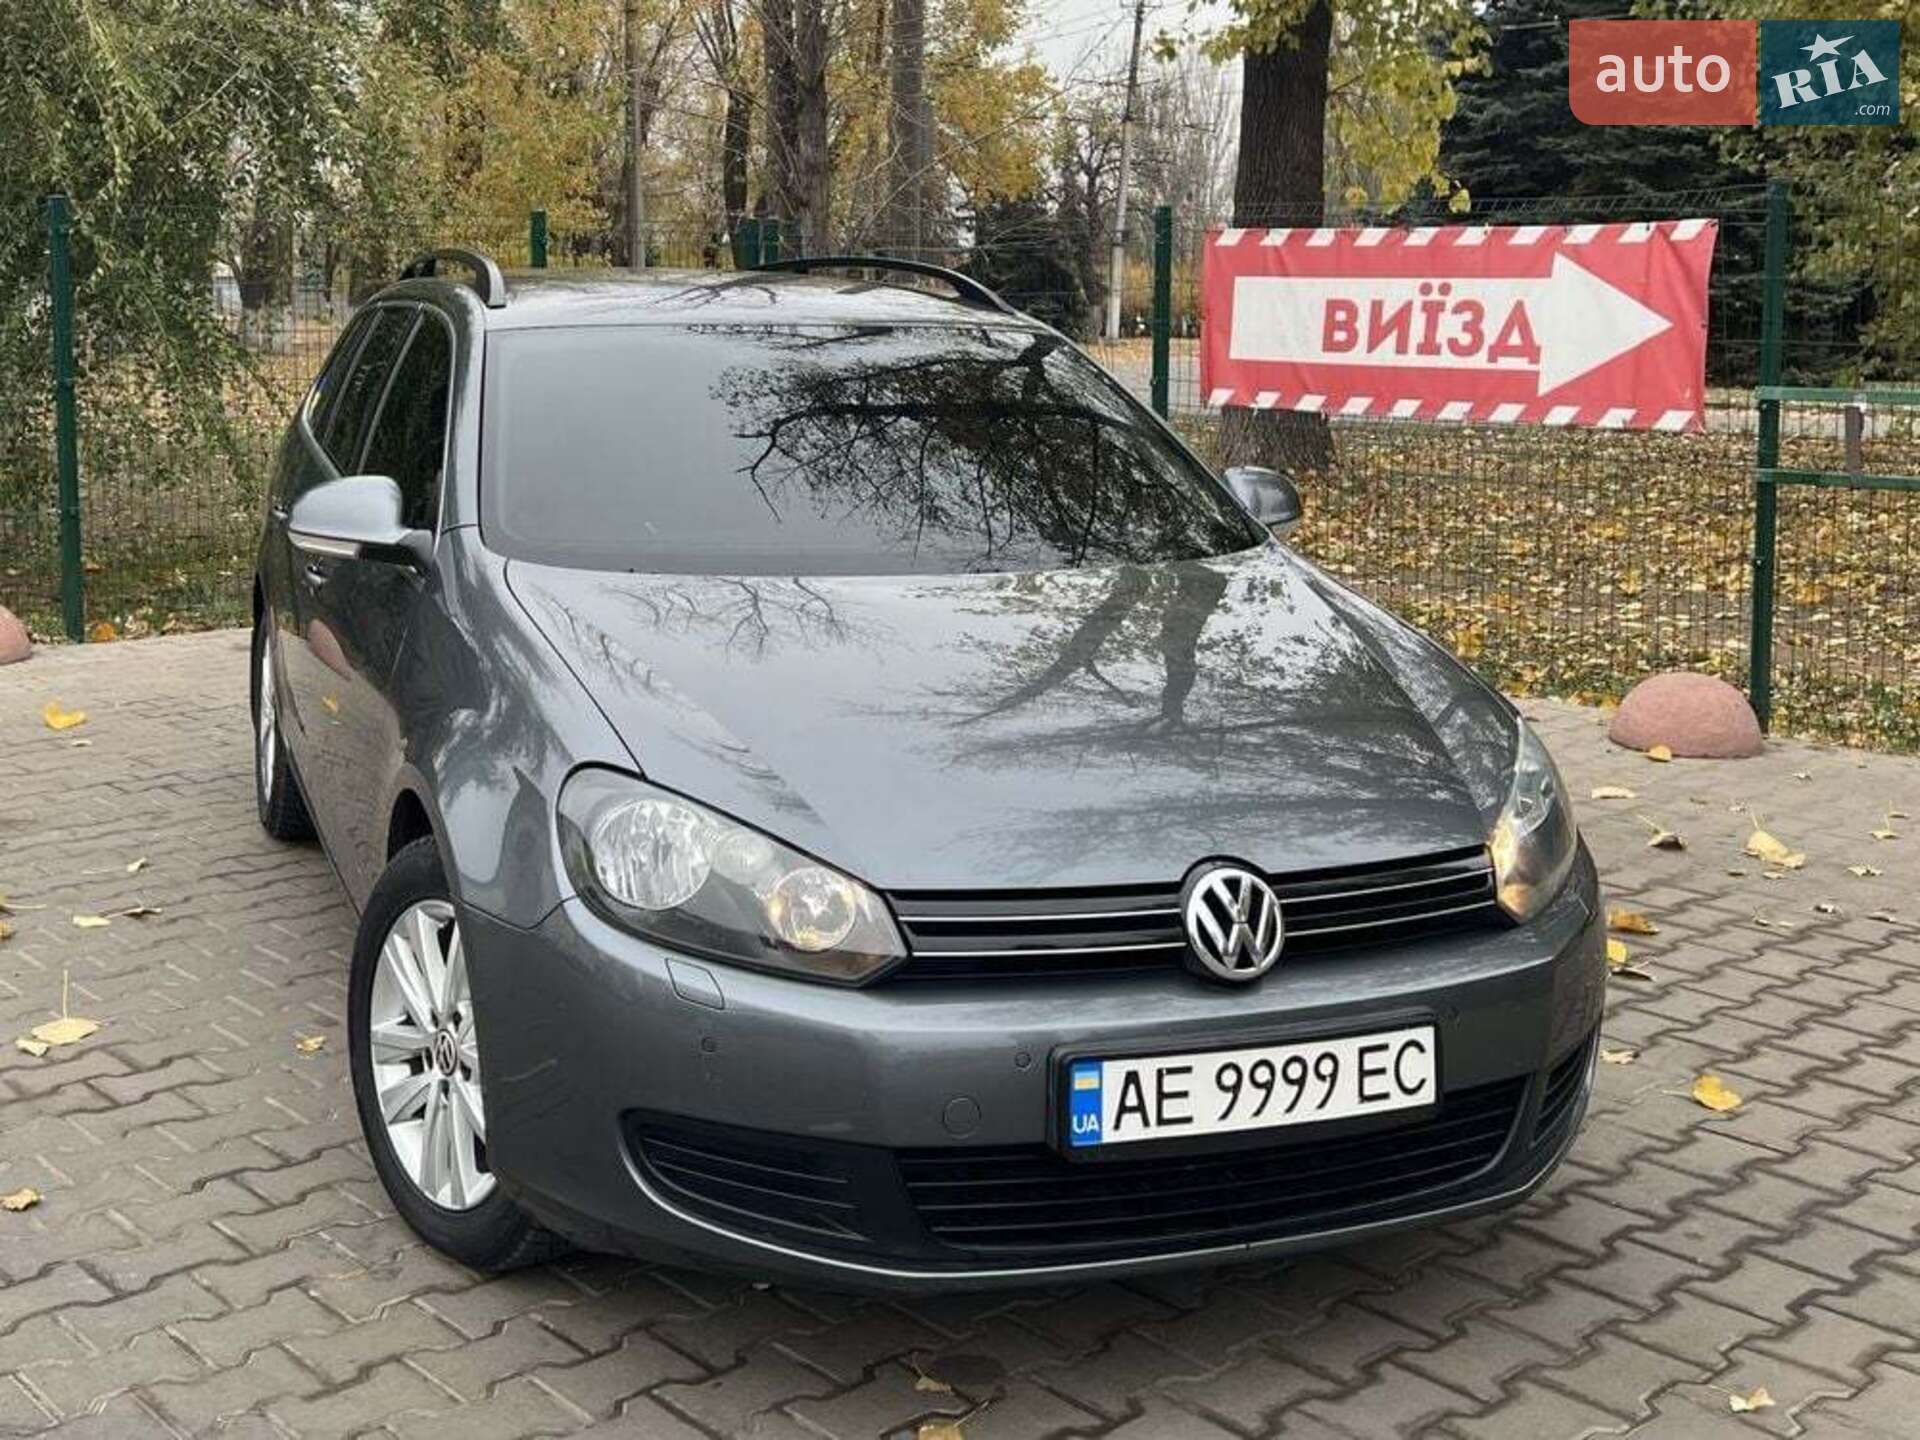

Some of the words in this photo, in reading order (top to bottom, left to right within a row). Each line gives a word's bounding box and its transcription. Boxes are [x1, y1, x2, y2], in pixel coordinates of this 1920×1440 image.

[1321, 281, 1542, 364] ВИЇЗД
[1072, 1113, 1100, 1135] UA
[1112, 1065, 1194, 1131] AE
[1215, 1051, 1340, 1121] 9999
[1358, 1039, 1427, 1104] EC
